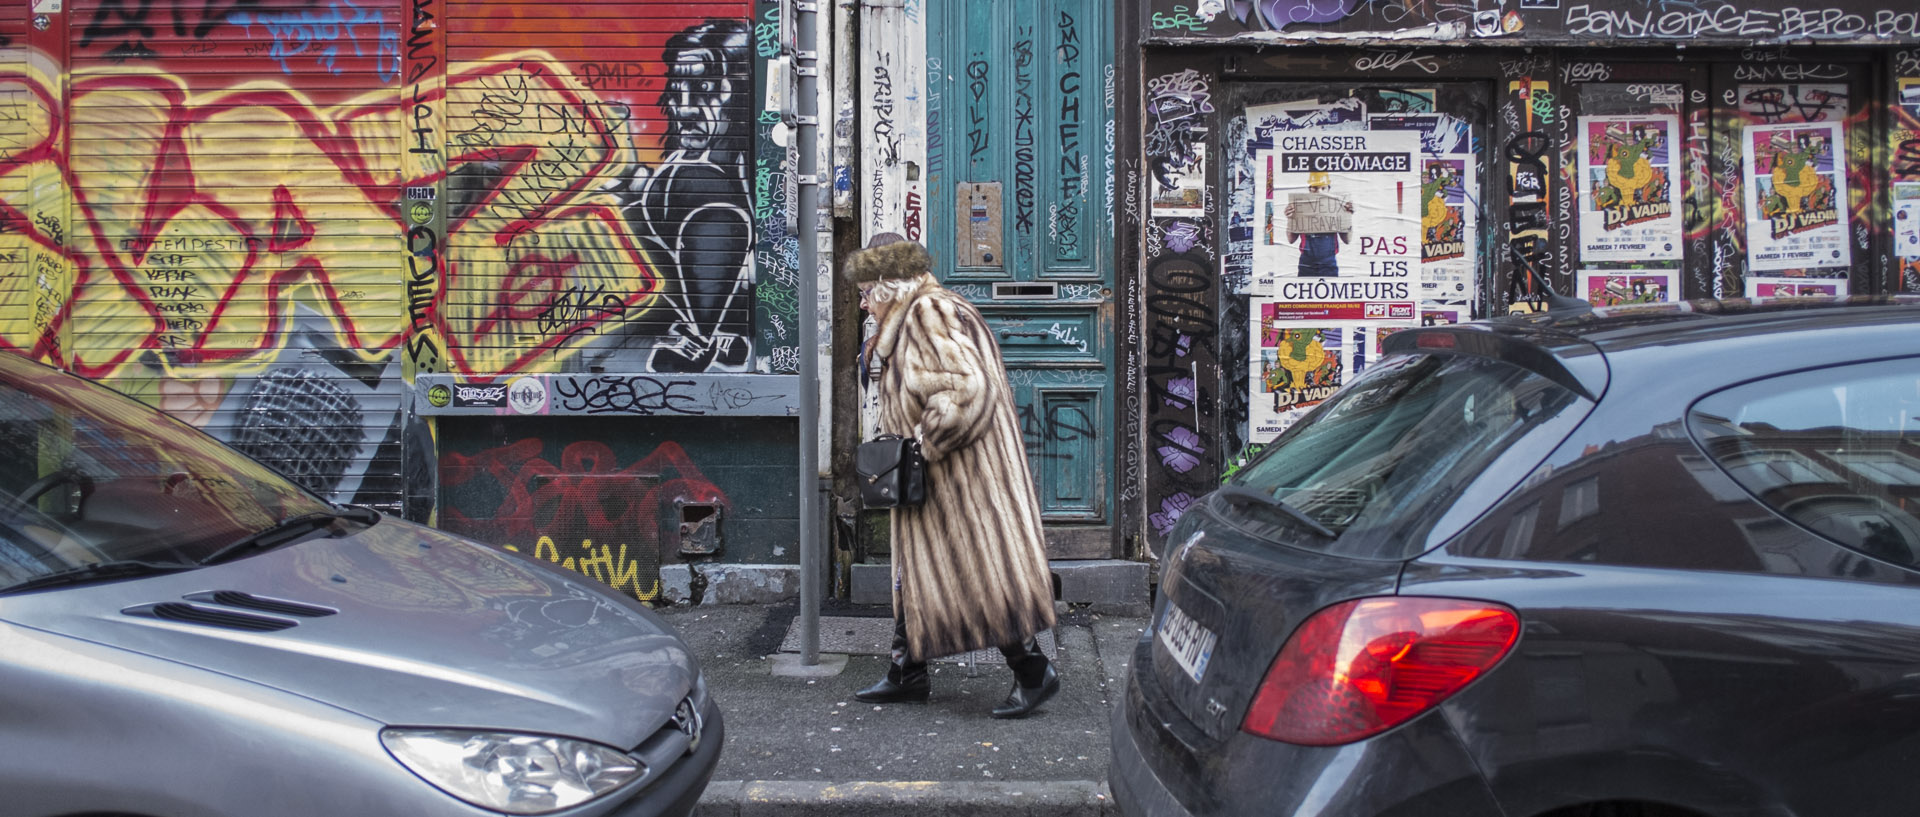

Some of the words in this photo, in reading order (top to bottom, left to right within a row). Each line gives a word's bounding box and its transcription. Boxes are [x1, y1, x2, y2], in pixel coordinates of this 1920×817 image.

[1282, 136, 1366, 151] CHASSER
[1287, 156, 1310, 171] LE
[1313, 153, 1406, 171] CHÔMAGE
[1308, 195, 1346, 213] VEUX
[1607, 207, 1629, 226] DJ
[1631, 202, 1672, 219] VADIM
[1774, 215, 1796, 234] DJ
[1798, 209, 1838, 227] VADIM
[1291, 216, 1304, 231] DU
[1306, 216, 1345, 231] TRAVAIL
[1360, 236, 1407, 255] PAS
[1424, 242, 1464, 258] VADIM
[1370, 261, 1408, 277] LES
[1283, 279, 1409, 299] CHÔMEURS
[1366, 304, 1385, 315] PCF
[1277, 390, 1298, 406] DJ
